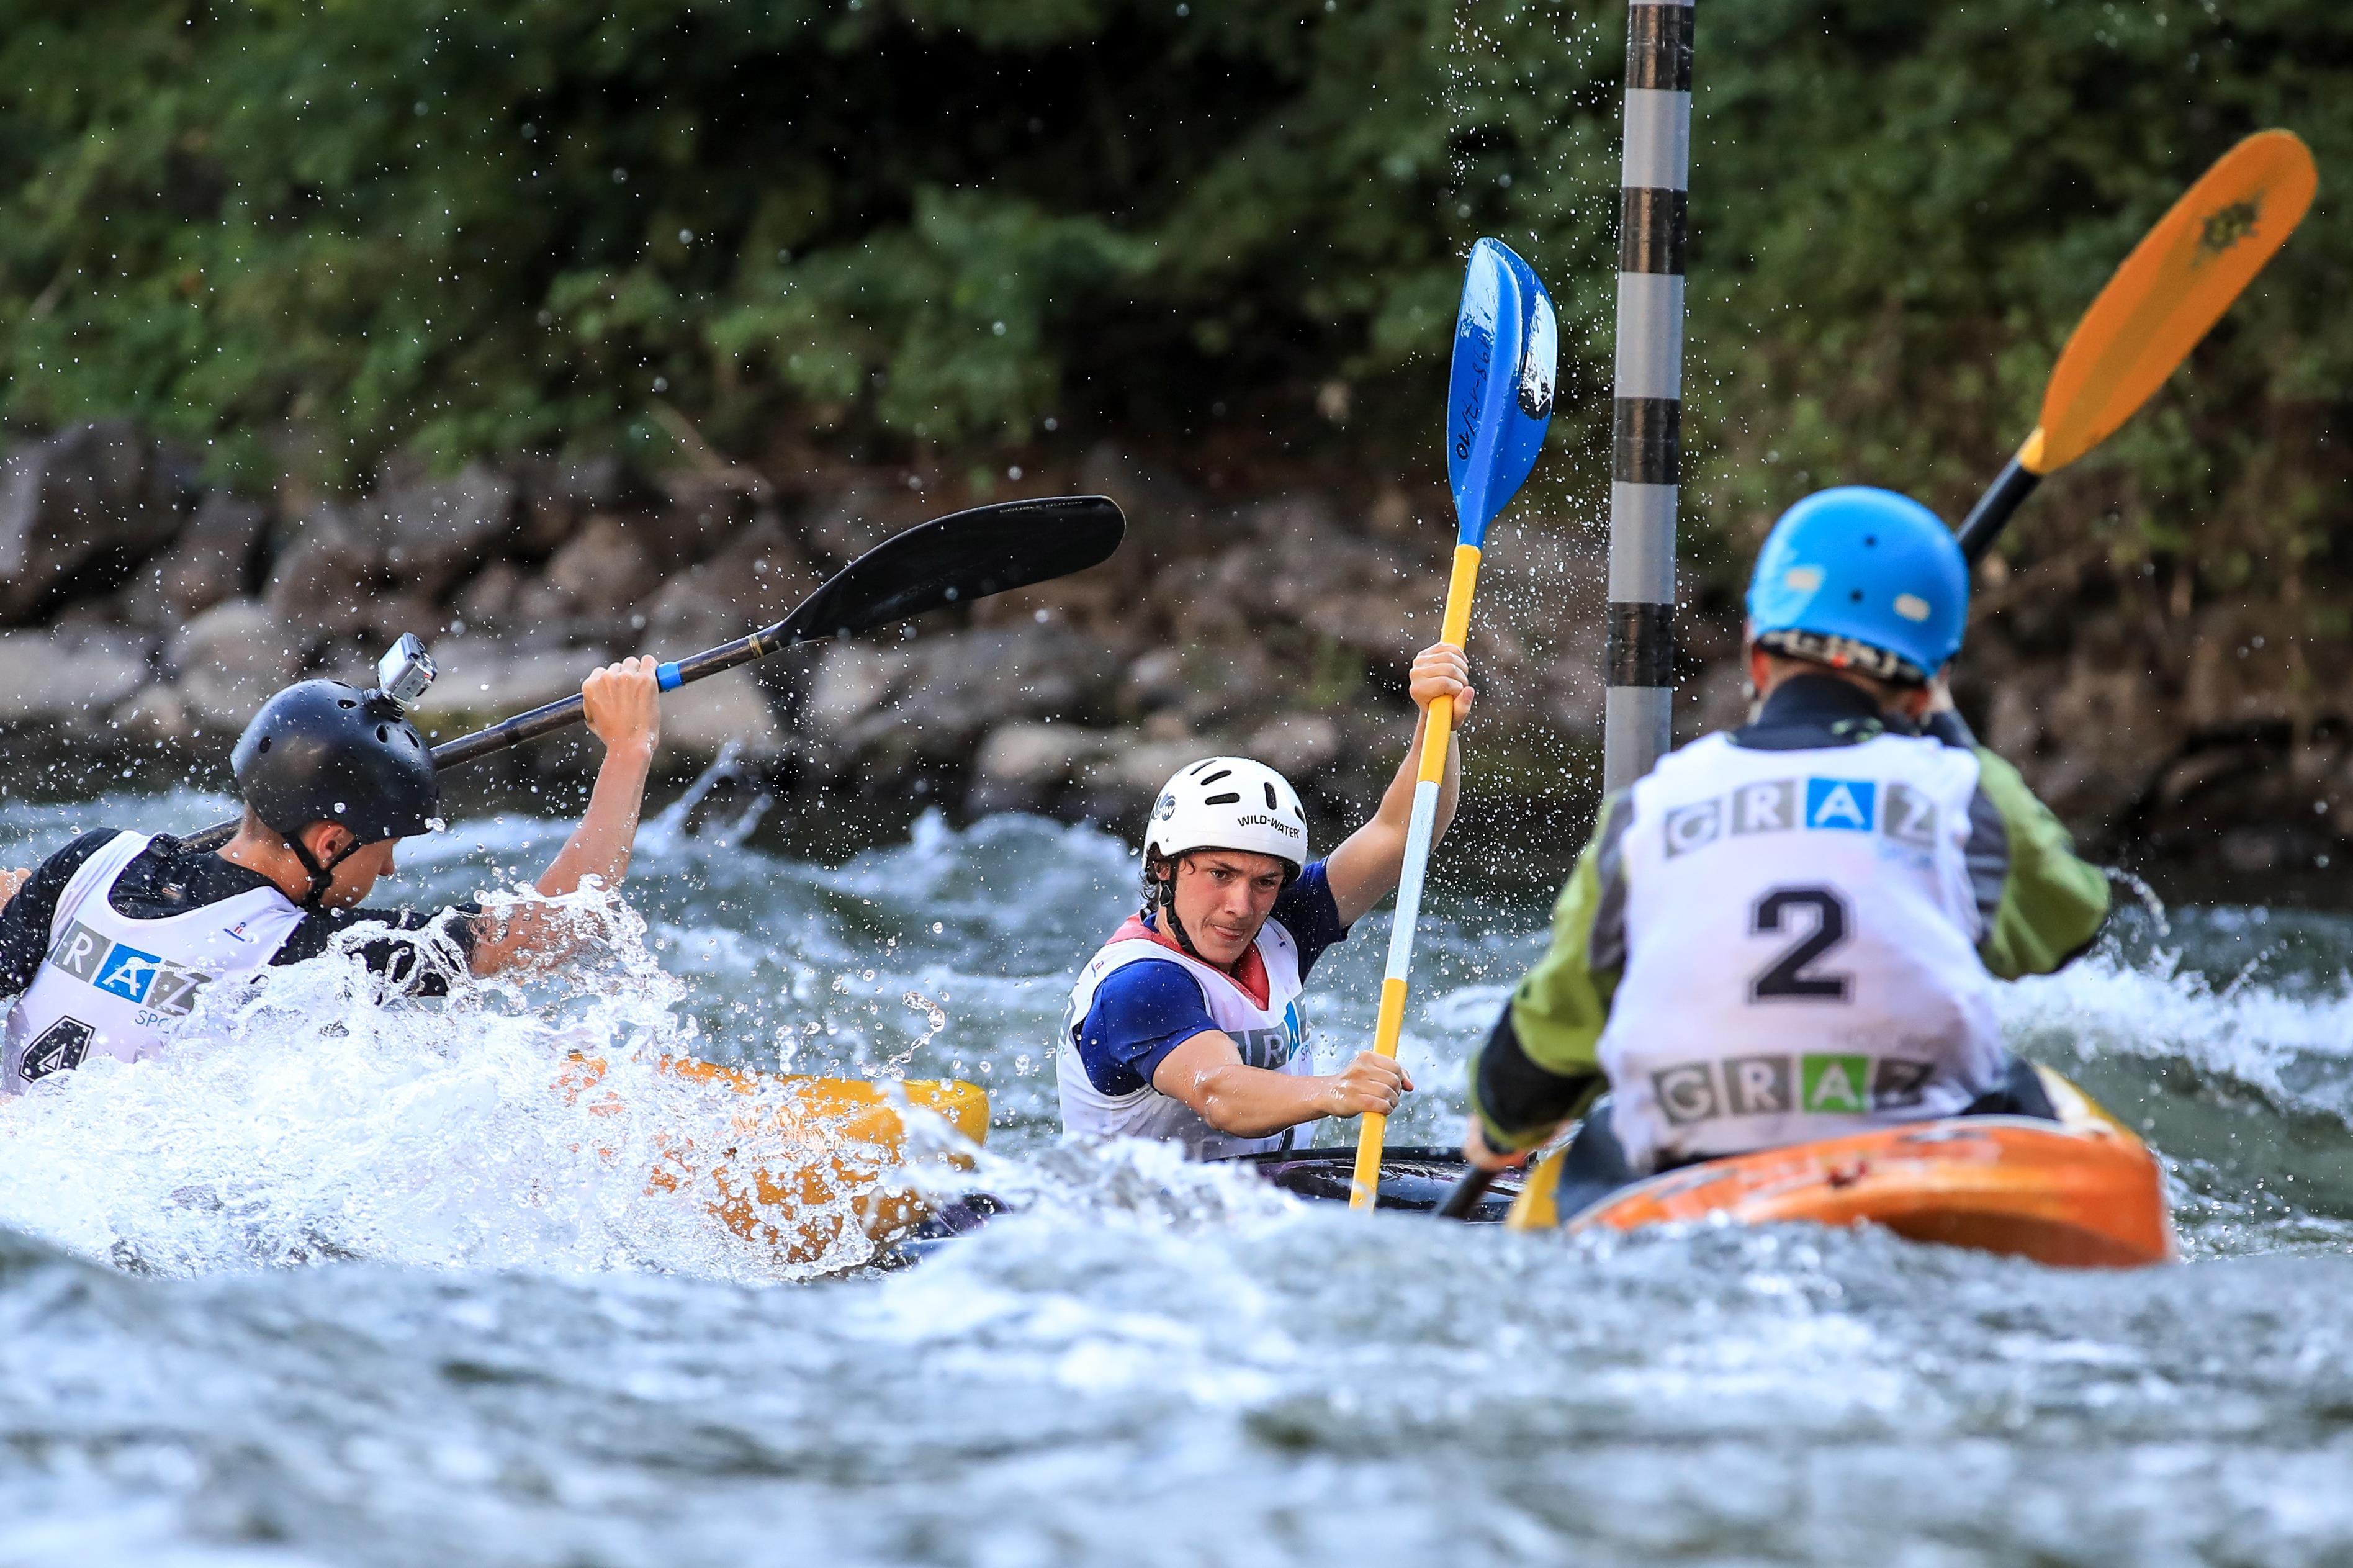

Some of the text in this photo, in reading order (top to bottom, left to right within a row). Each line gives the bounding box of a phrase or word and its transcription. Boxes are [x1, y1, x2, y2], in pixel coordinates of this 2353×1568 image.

[1237, 814, 1300, 839] WILD-WATER
[1667, 781, 1936, 849] GRAZ
[48, 928, 202, 1014] RAZ
[1753, 888, 1846, 998] 2
[1660, 1058, 1922, 1115] GRAZ
